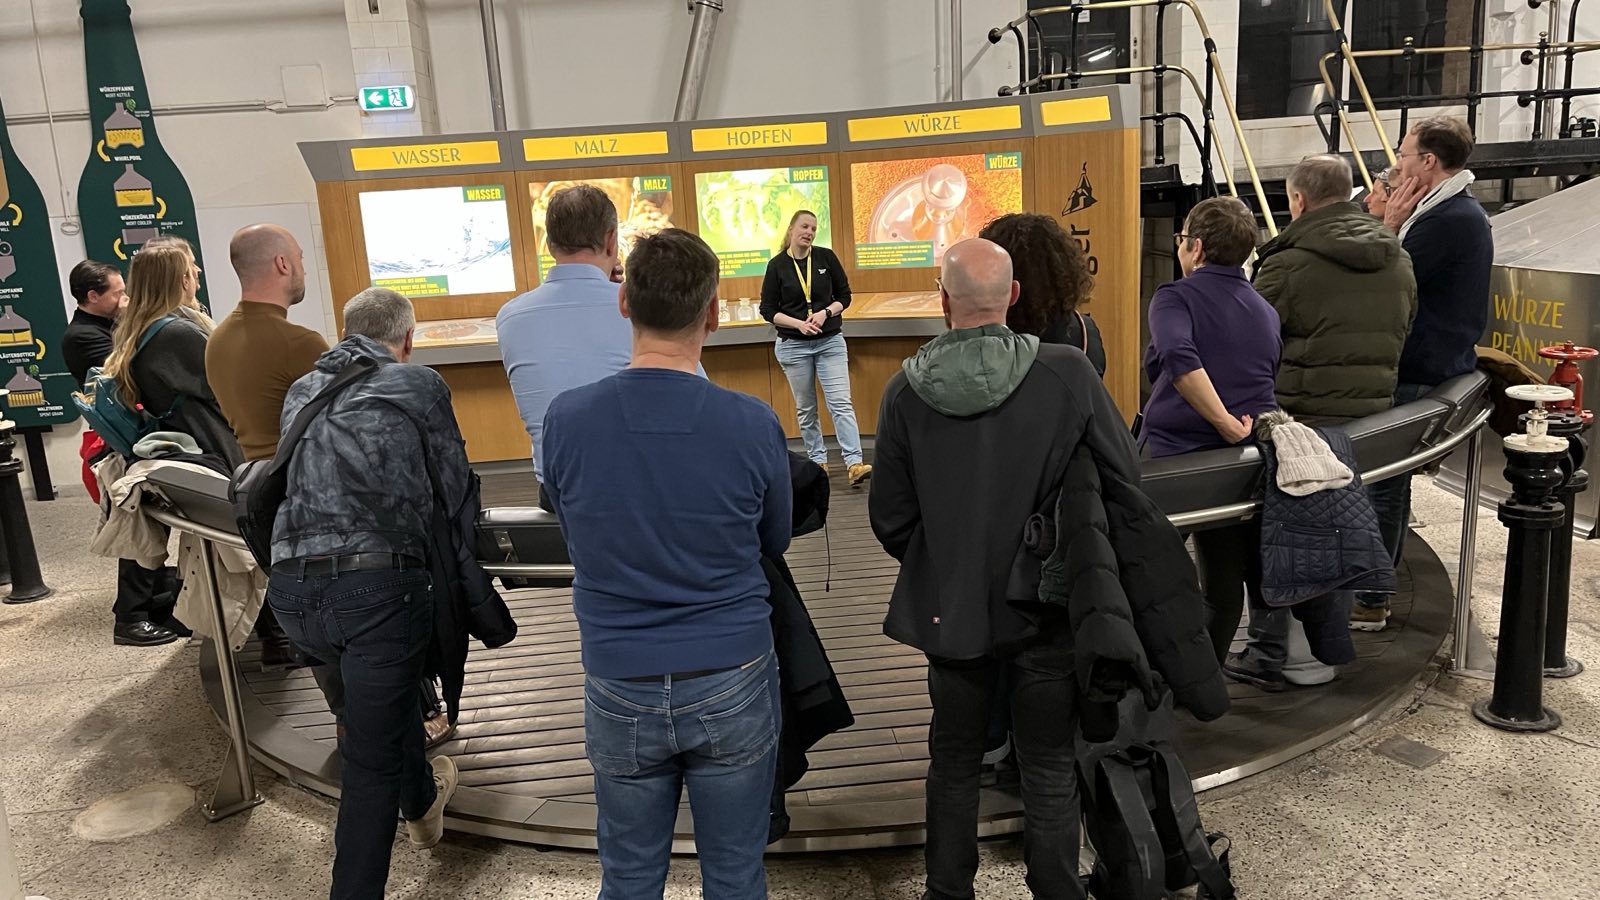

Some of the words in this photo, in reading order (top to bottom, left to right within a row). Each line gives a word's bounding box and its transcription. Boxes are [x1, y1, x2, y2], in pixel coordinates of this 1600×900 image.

[904, 114, 962, 133] WÜRZE
[727, 129, 792, 145] HOPFEN
[574, 139, 619, 154] MALZ
[392, 148, 461, 164] WASSER
[988, 155, 1018, 169] WÜRZE
[792, 169, 823, 181] HOPFEN
[643, 178, 667, 190] MALZ
[466, 188, 501, 201] WASSER
[1494, 290, 1565, 329] WÜRZE
